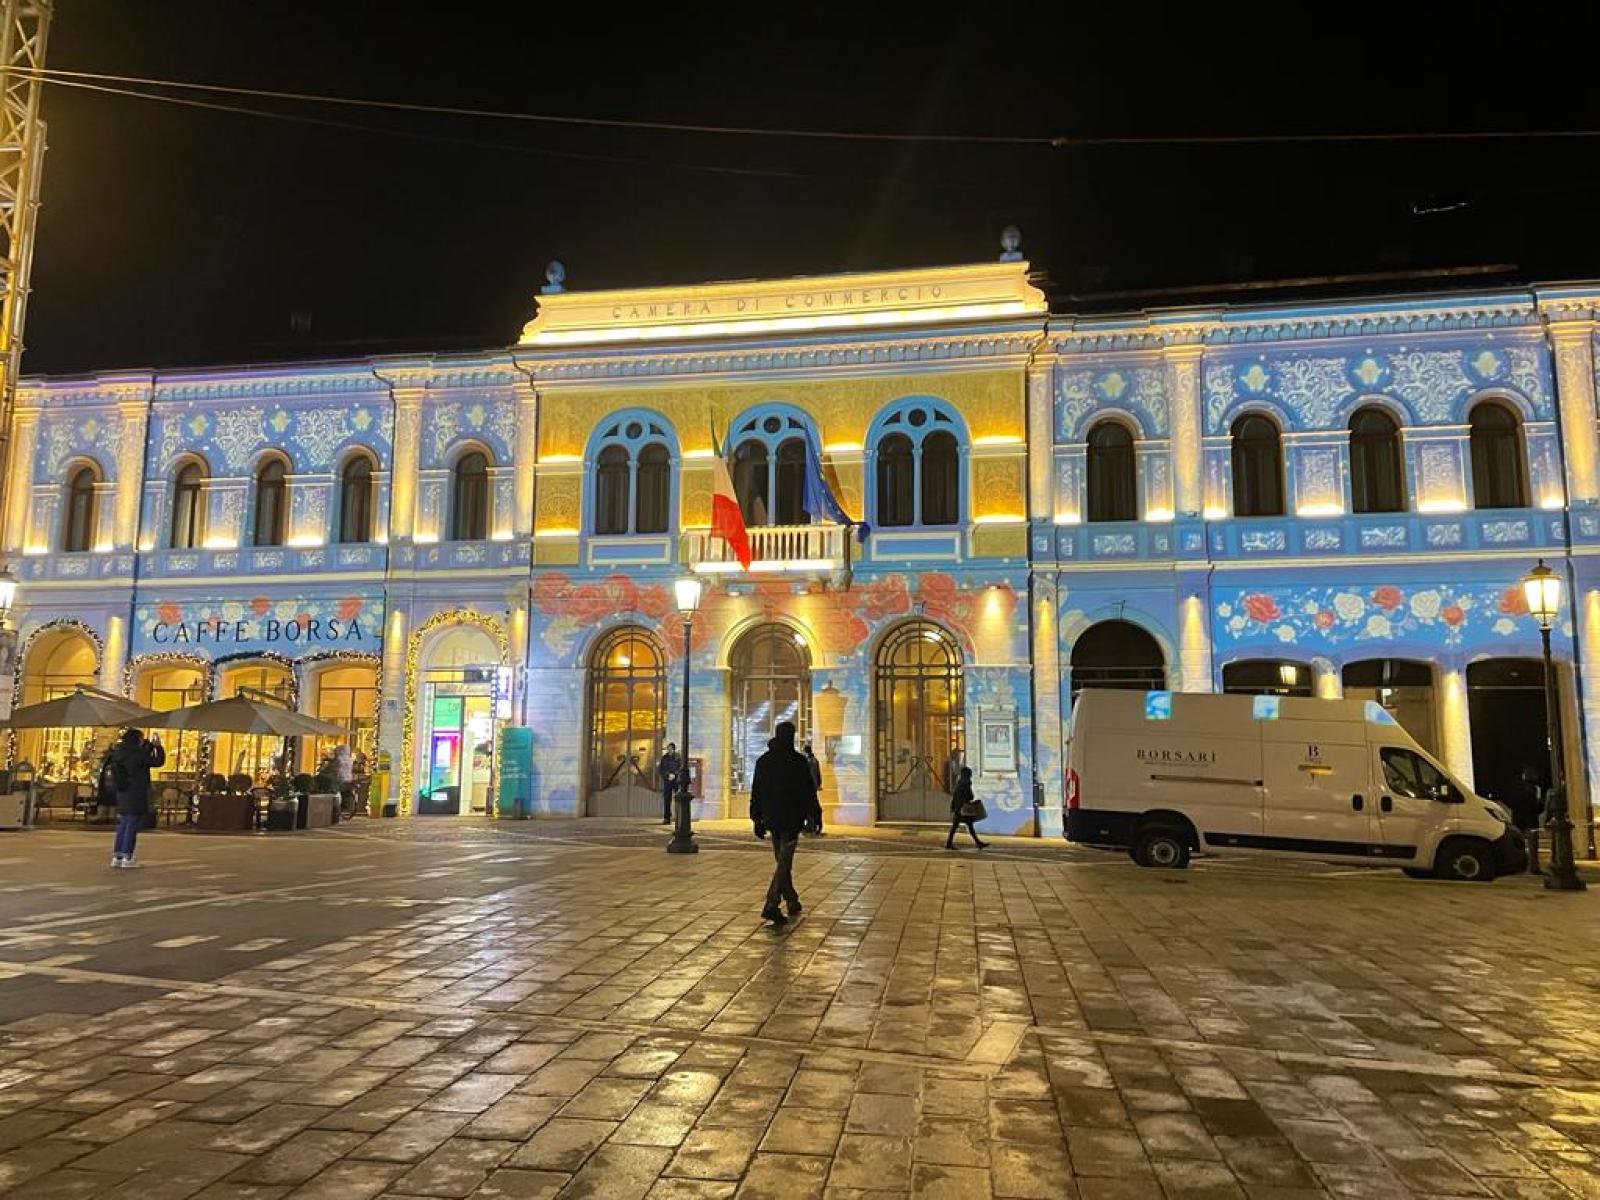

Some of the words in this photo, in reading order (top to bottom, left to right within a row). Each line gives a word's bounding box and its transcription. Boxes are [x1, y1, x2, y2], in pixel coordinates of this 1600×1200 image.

[612, 299, 711, 319] CAMERA
[737, 299, 760, 312] DI
[785, 286, 942, 308] COMMERCIO
[266, 619, 362, 642] BORSA
[1136, 749, 1216, 763] BORSARI
